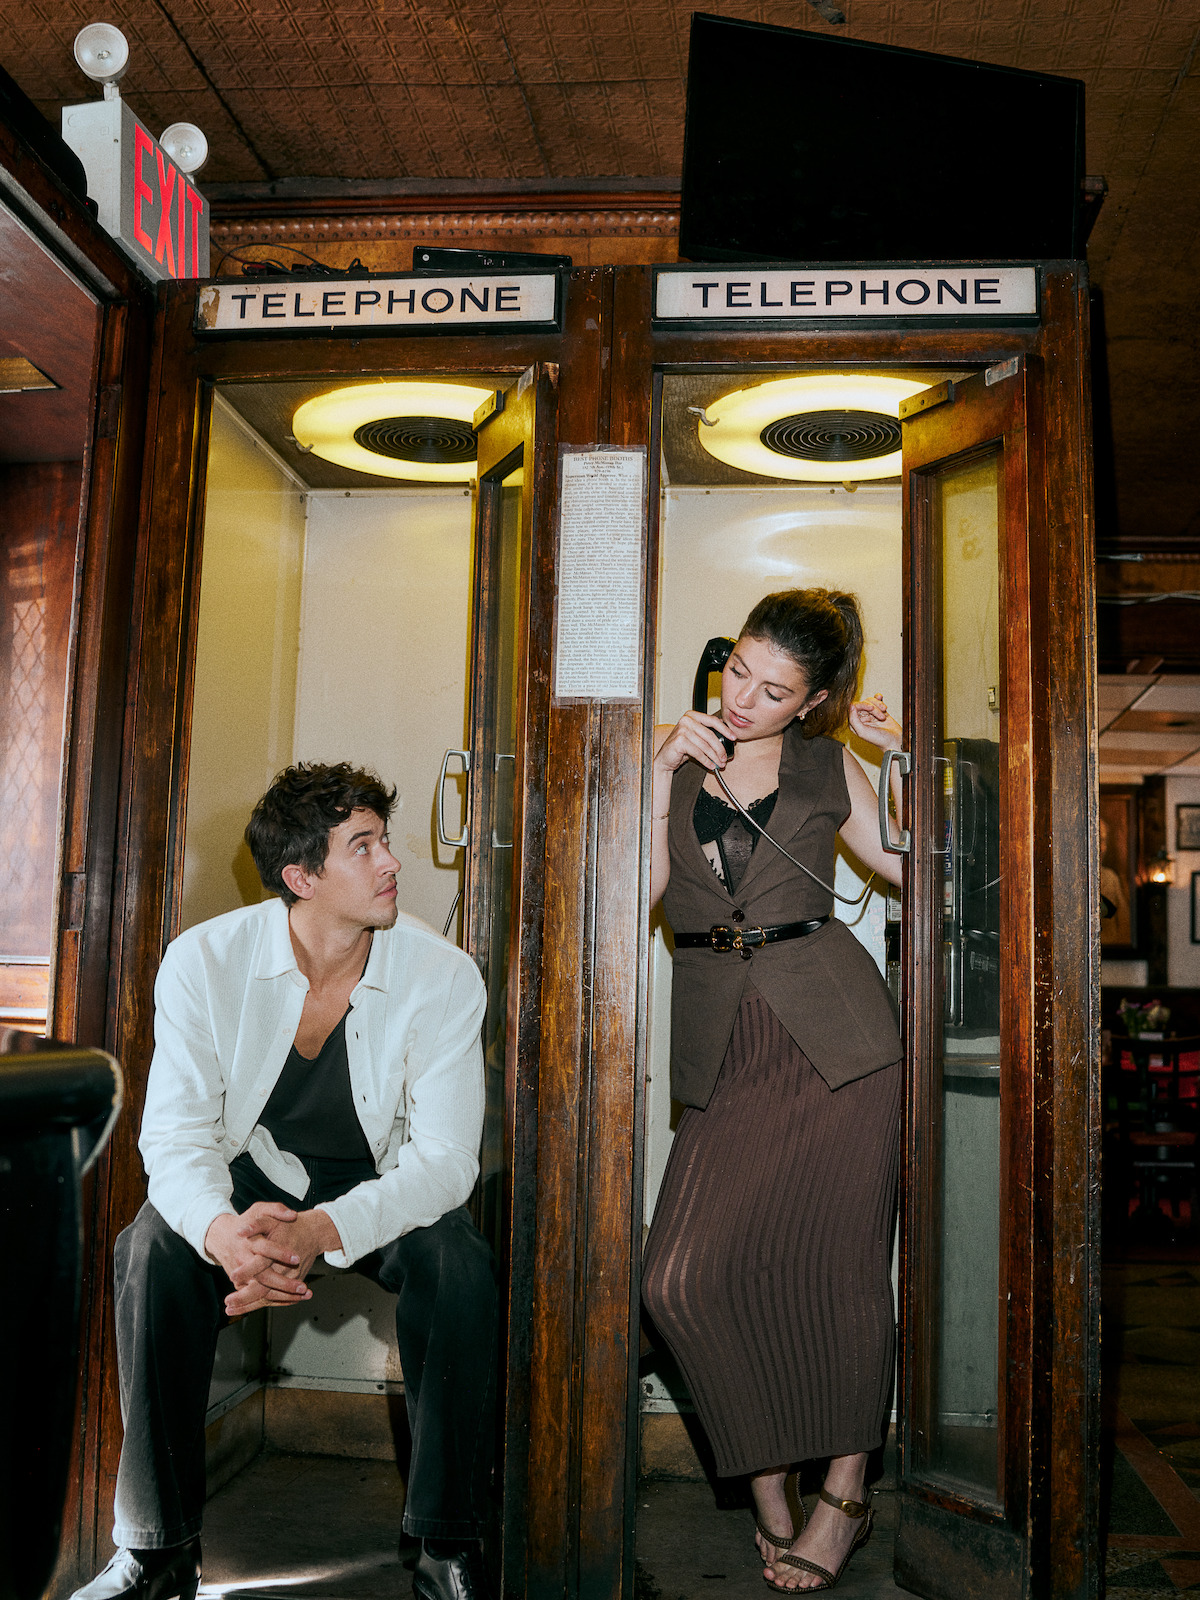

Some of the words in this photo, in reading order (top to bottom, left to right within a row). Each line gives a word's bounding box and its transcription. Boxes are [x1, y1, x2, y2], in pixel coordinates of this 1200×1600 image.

[134, 122, 203, 279] EXIT
[232, 286, 521, 319] TELEPHONE
[693, 279, 1001, 308] TELEPHONE
